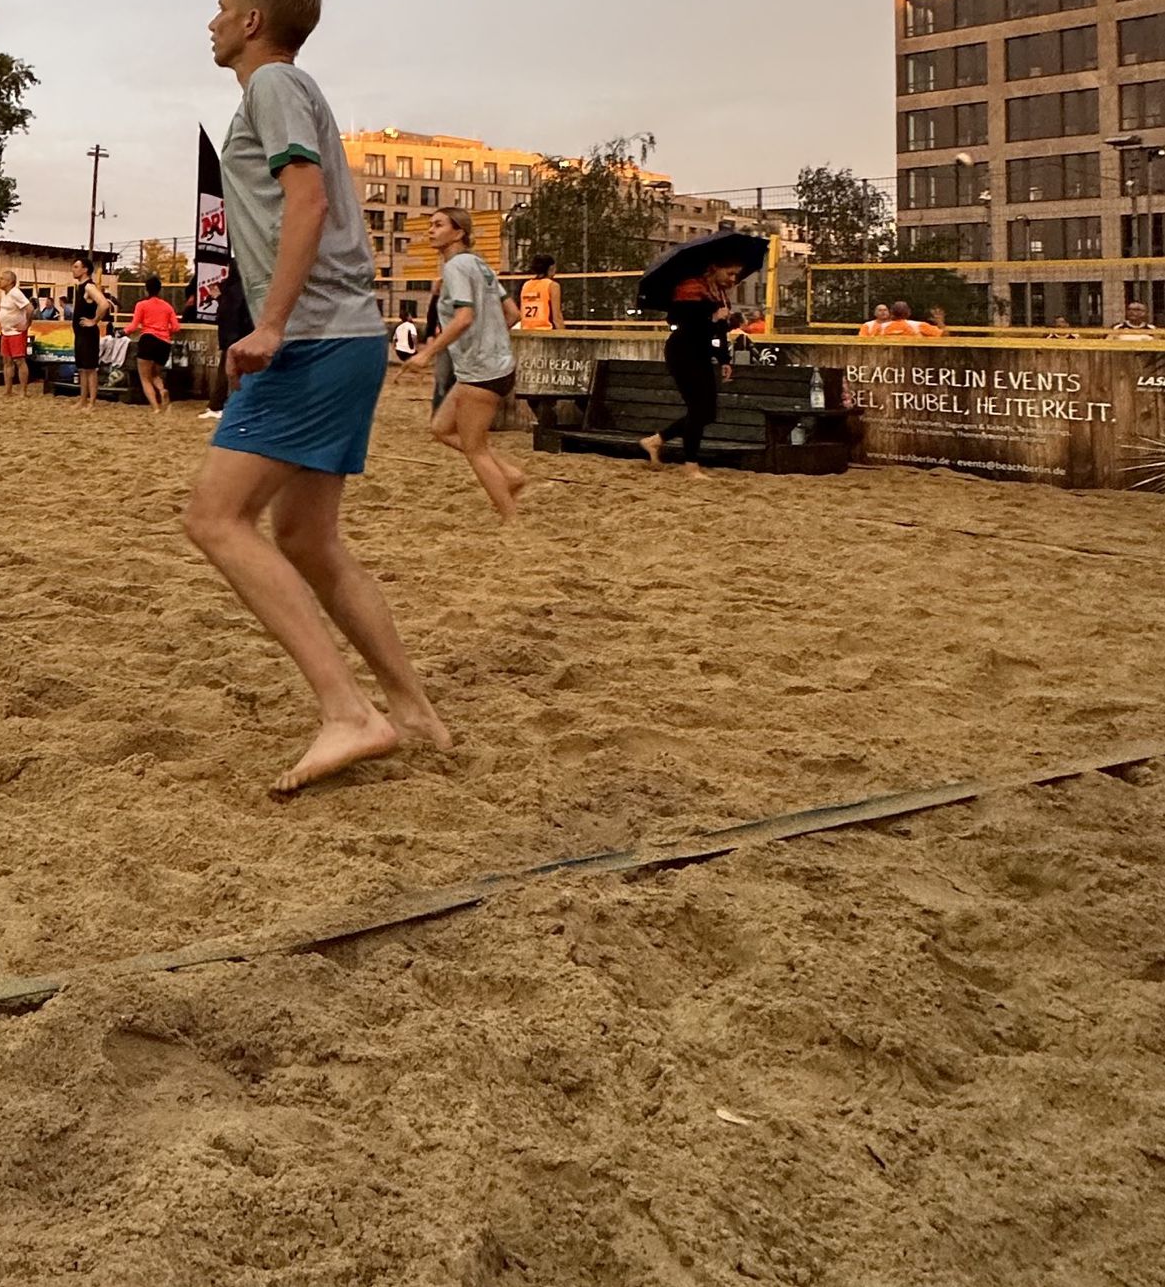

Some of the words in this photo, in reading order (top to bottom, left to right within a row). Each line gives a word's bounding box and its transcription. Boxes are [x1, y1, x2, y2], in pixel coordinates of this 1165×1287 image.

[525, 306, 538, 318] 27
[846, 365, 906, 384] BEACH
[912, 367, 987, 388] BERLIN
[994, 370, 1081, 392] EVENTS
[1137, 376, 1165, 386] LAS
[891, 392, 970, 415] TRUBEL,
[976, 396, 1116, 422] HEITERKEIT.
[956, 459, 1067, 476] events@beachberlin.de
